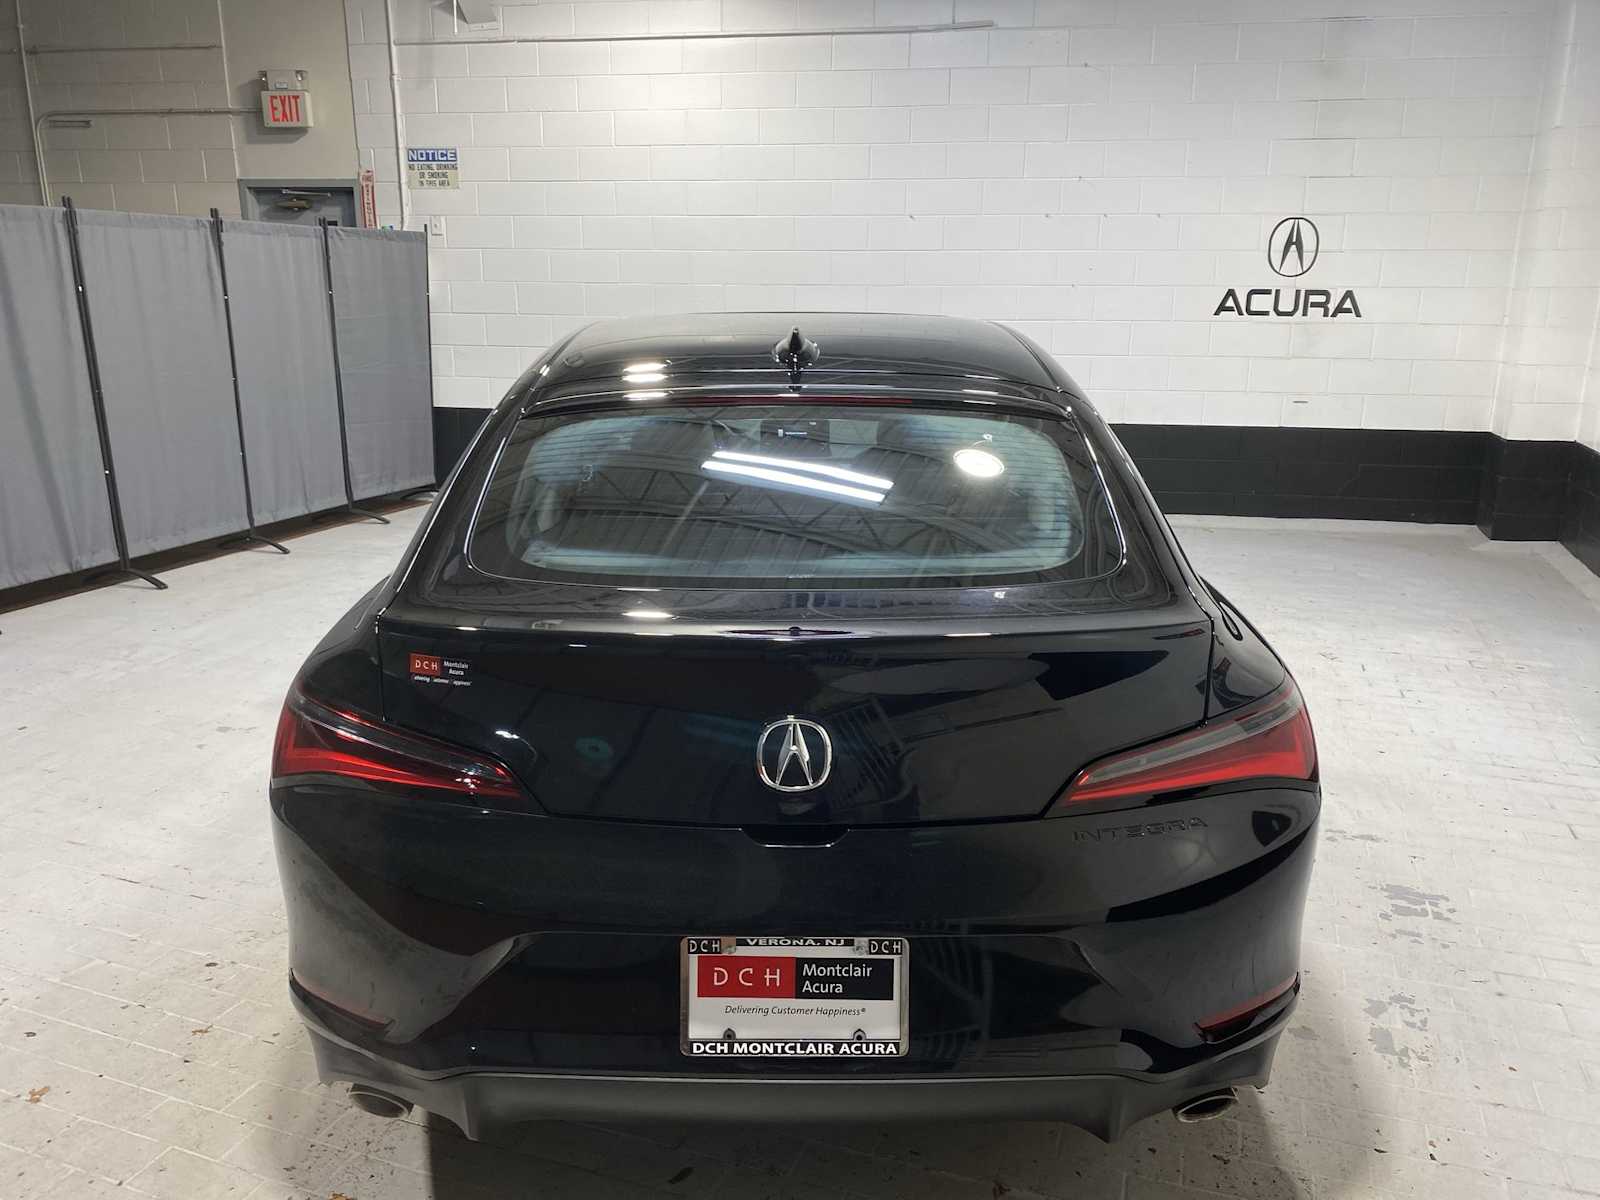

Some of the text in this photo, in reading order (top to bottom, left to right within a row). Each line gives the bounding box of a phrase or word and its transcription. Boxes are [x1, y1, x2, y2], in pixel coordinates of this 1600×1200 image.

[269, 95, 300, 122] EXIT
[408, 149, 457, 161] NOTICE
[427, 171, 449, 179] SMOKING
[1213, 288, 1362, 318] ACURA
[1073, 816, 1209, 842] INTEGRA
[824, 938, 845, 946] NJ
[802, 963, 873, 977] Montclair
[802, 980, 843, 993] Acura
[724, 1005, 769, 1016] Delivering
[771, 1006, 814, 1015] Customer
[692, 1042, 898, 1055] DCH MONTCLAIR ACURA
